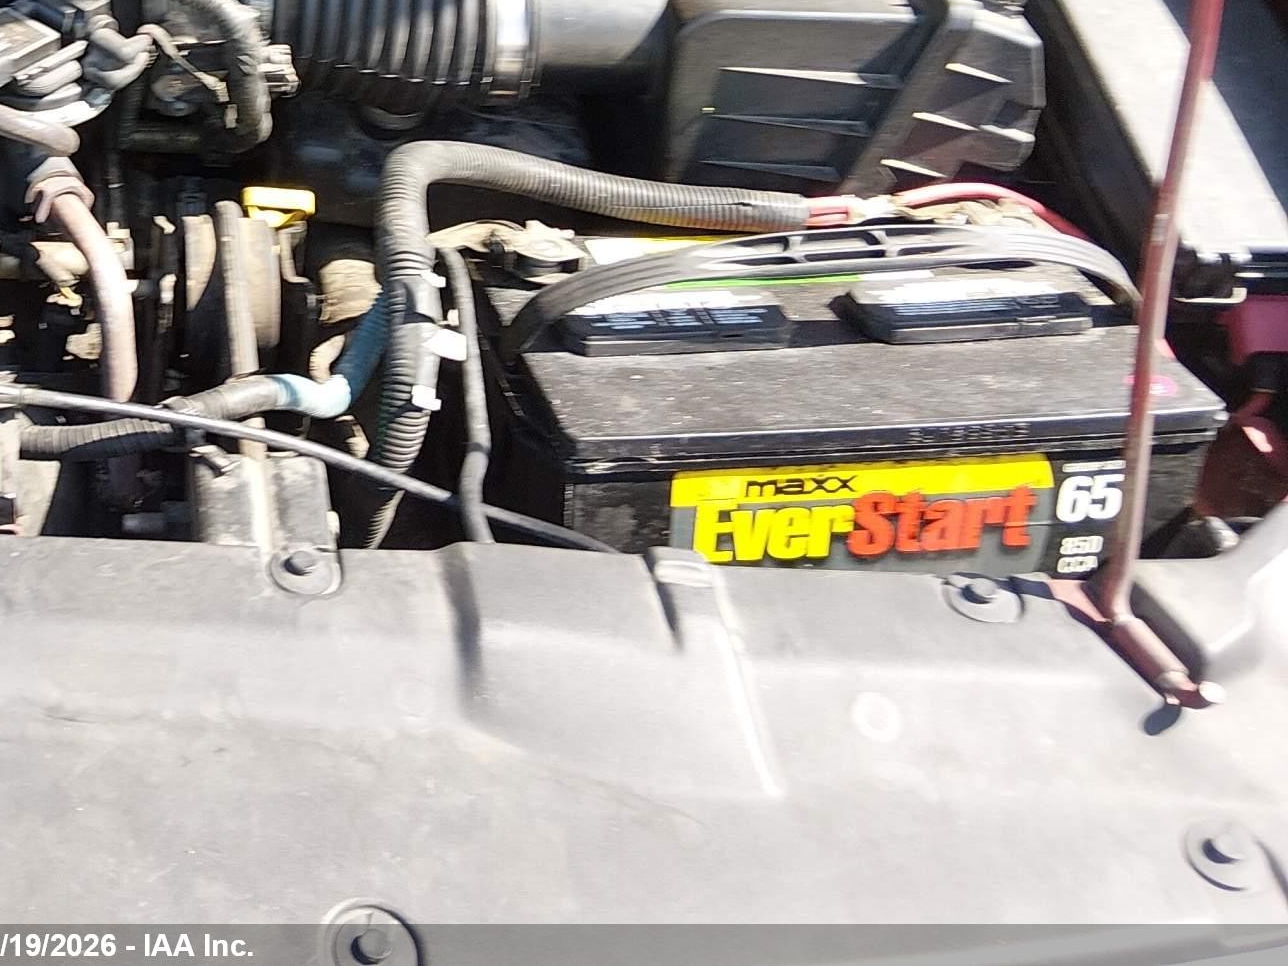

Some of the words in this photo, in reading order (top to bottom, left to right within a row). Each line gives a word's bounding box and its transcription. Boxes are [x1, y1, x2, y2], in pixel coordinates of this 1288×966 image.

[745, 474, 858, 497] maxx
[1056, 474, 1126, 522] 65
[693, 487, 1035, 562] EverStart
